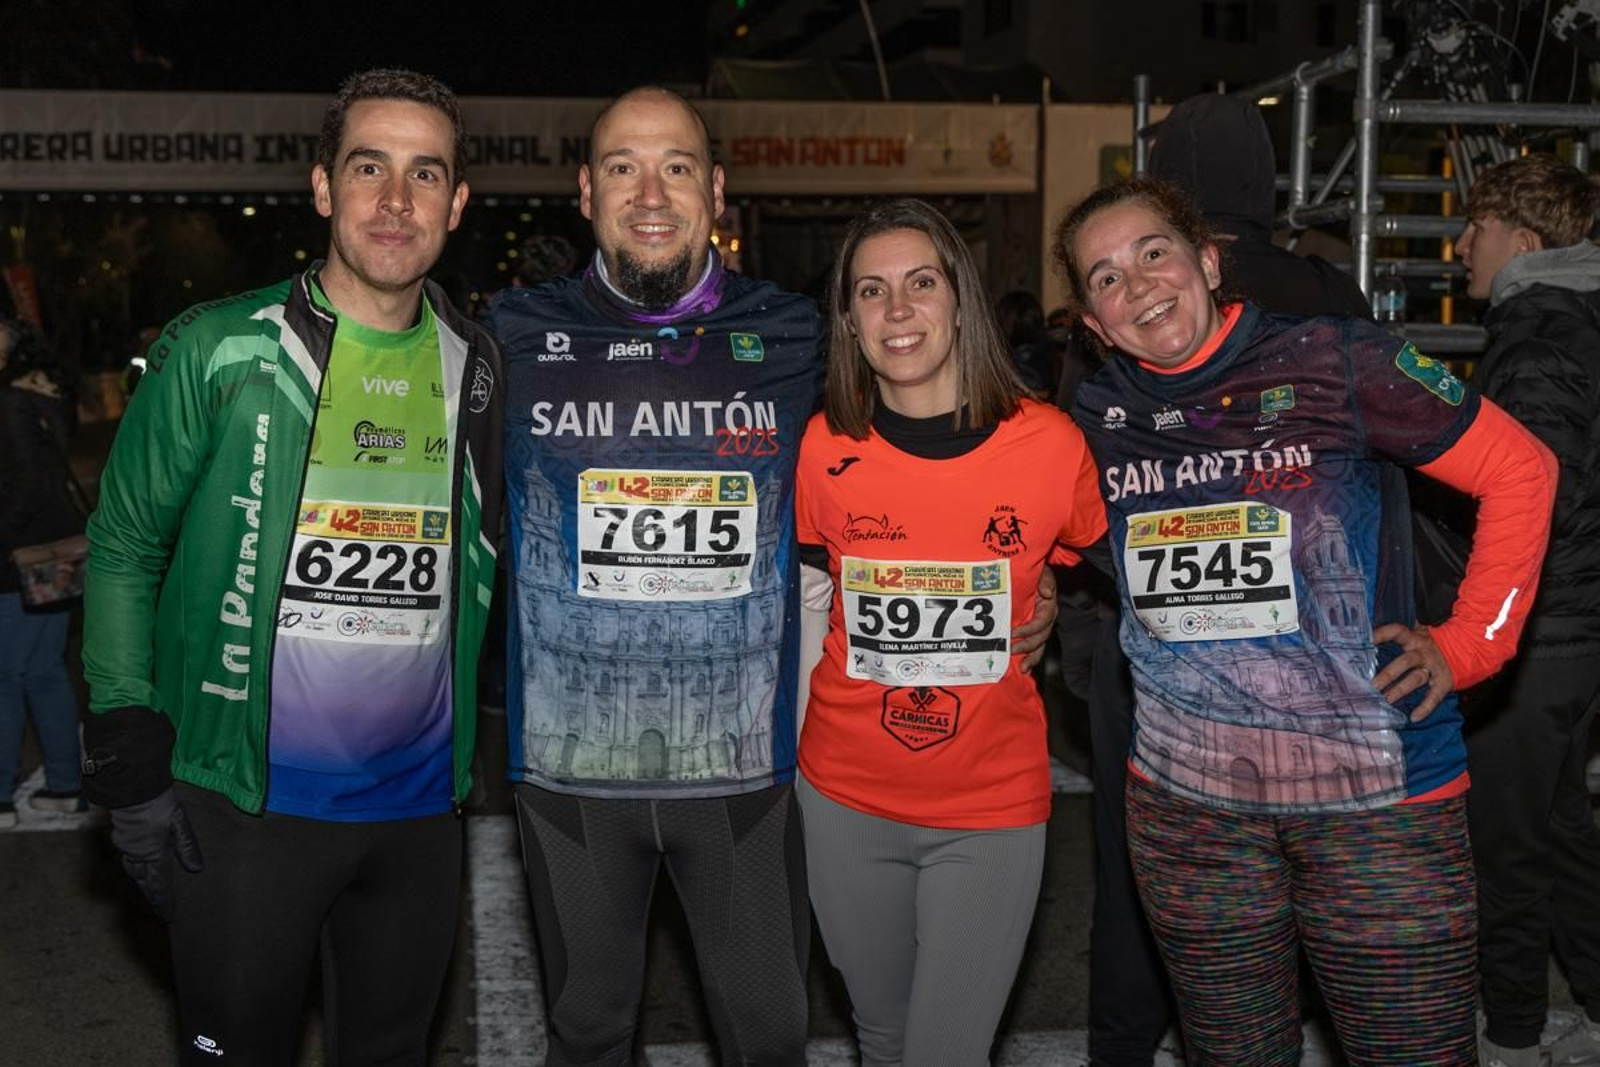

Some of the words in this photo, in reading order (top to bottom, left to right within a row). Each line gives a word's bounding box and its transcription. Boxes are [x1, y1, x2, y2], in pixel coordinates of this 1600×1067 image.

[104, 133, 244, 162] URBANA
[730, 138, 796, 167] SAN
[799, 137, 907, 167] ANTON
[362, 375, 410, 397] vive
[530, 401, 614, 437] SAN
[629, 392, 778, 437] ANTÓN
[357, 433, 406, 449] ARIAS
[715, 426, 780, 457] 2025
[1106, 459, 1165, 502] SAN
[1175, 438, 1312, 488] ANTÓN
[618, 477, 650, 499] 42
[650, 488, 674, 498] SAN
[675, 488, 713, 498] AON
[330, 509, 361, 533] 42
[360, 522, 379, 533] SAN
[593, 508, 741, 553] 7615
[1157, 515, 1185, 538] 42
[1185, 523, 1205, 535] SAN
[295, 539, 438, 593] 6228
[644, 555, 685, 565] FERNÁNDEZ
[687, 557, 716, 565] BLANCO
[1138, 541, 1274, 593] 7545
[873, 567, 904, 589] 42
[904, 578, 926, 588] SAN
[334, 594, 359, 602] DAVID
[361, 595, 388, 604] TORRES
[1165, 595, 1185, 604] ALMA
[1187, 594, 1213, 602] TORRES
[1214, 592, 1245, 601] GALLEGO
[857, 595, 996, 639] 5973
